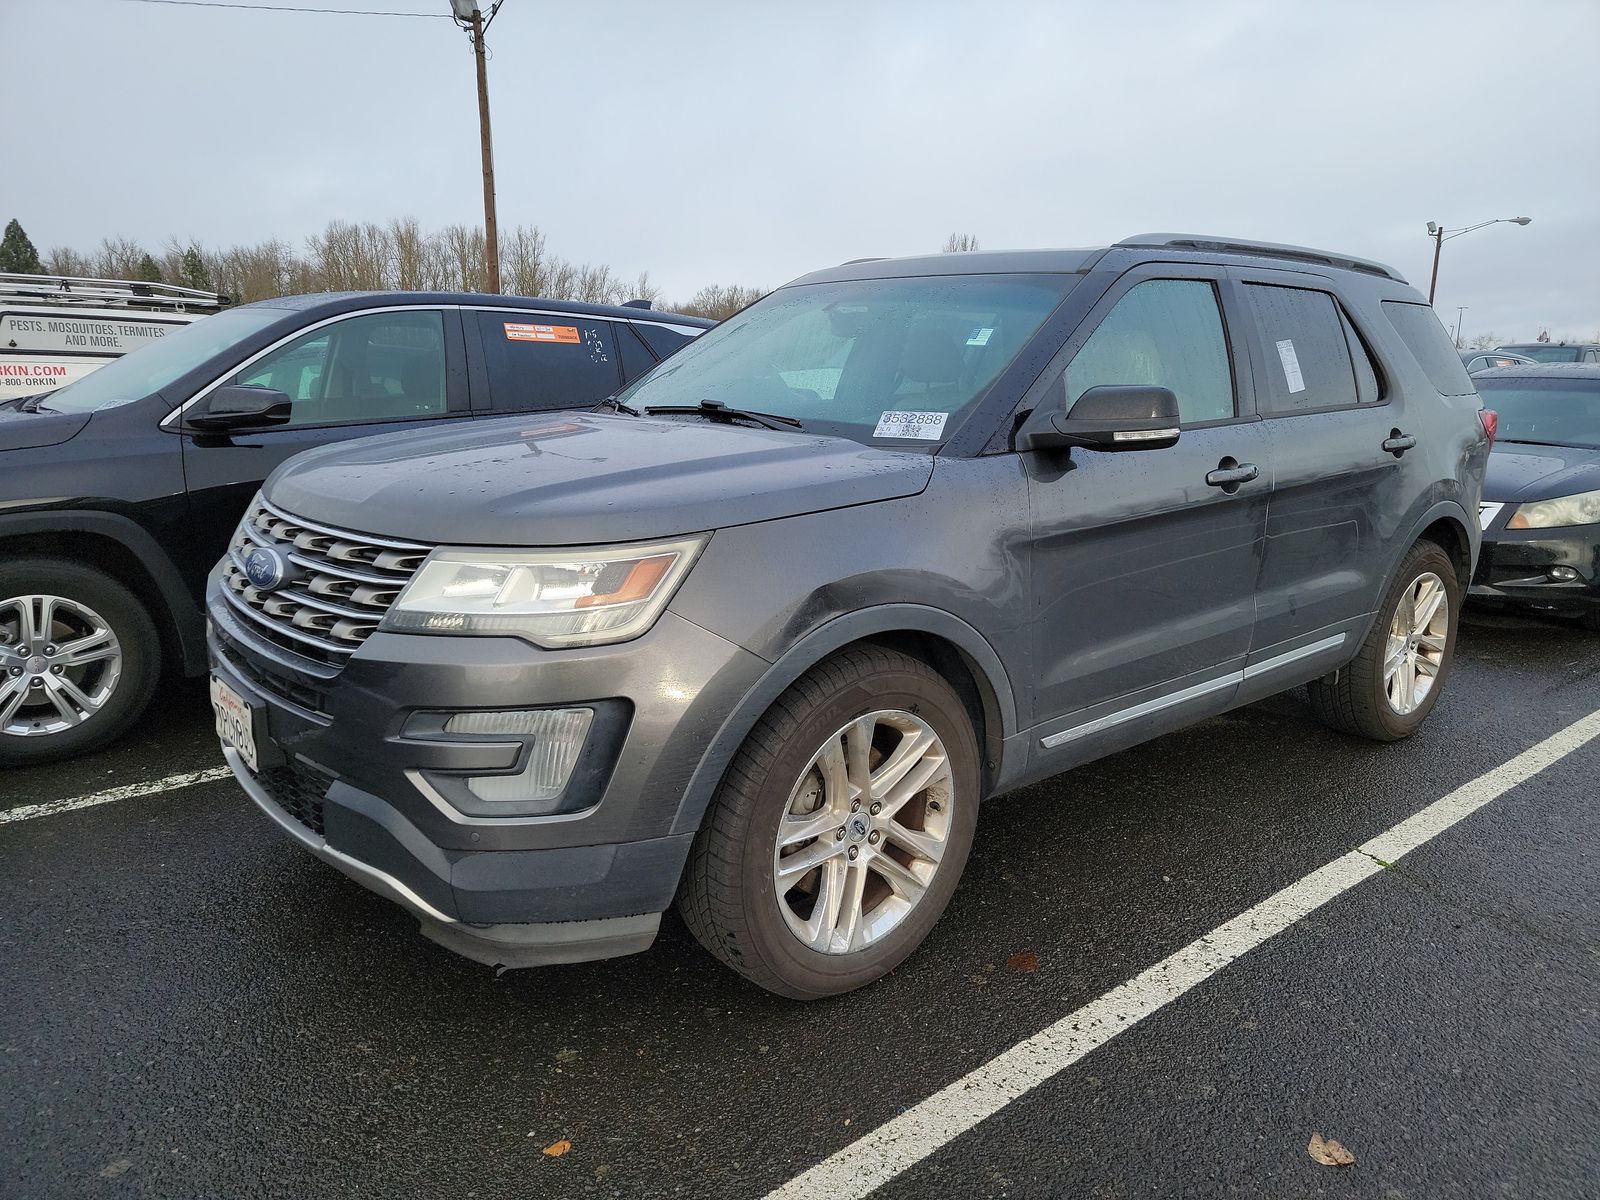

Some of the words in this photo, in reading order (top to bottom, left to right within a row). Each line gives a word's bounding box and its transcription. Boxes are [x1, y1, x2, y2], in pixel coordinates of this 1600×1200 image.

[10, 320, 46, 332] PESTS.
[48, 322, 117, 336] MOSQUITOES.
[65, 335, 87, 346] AND
[90, 336, 123, 348] MORE.
[882, 413, 943, 425] 3532888
